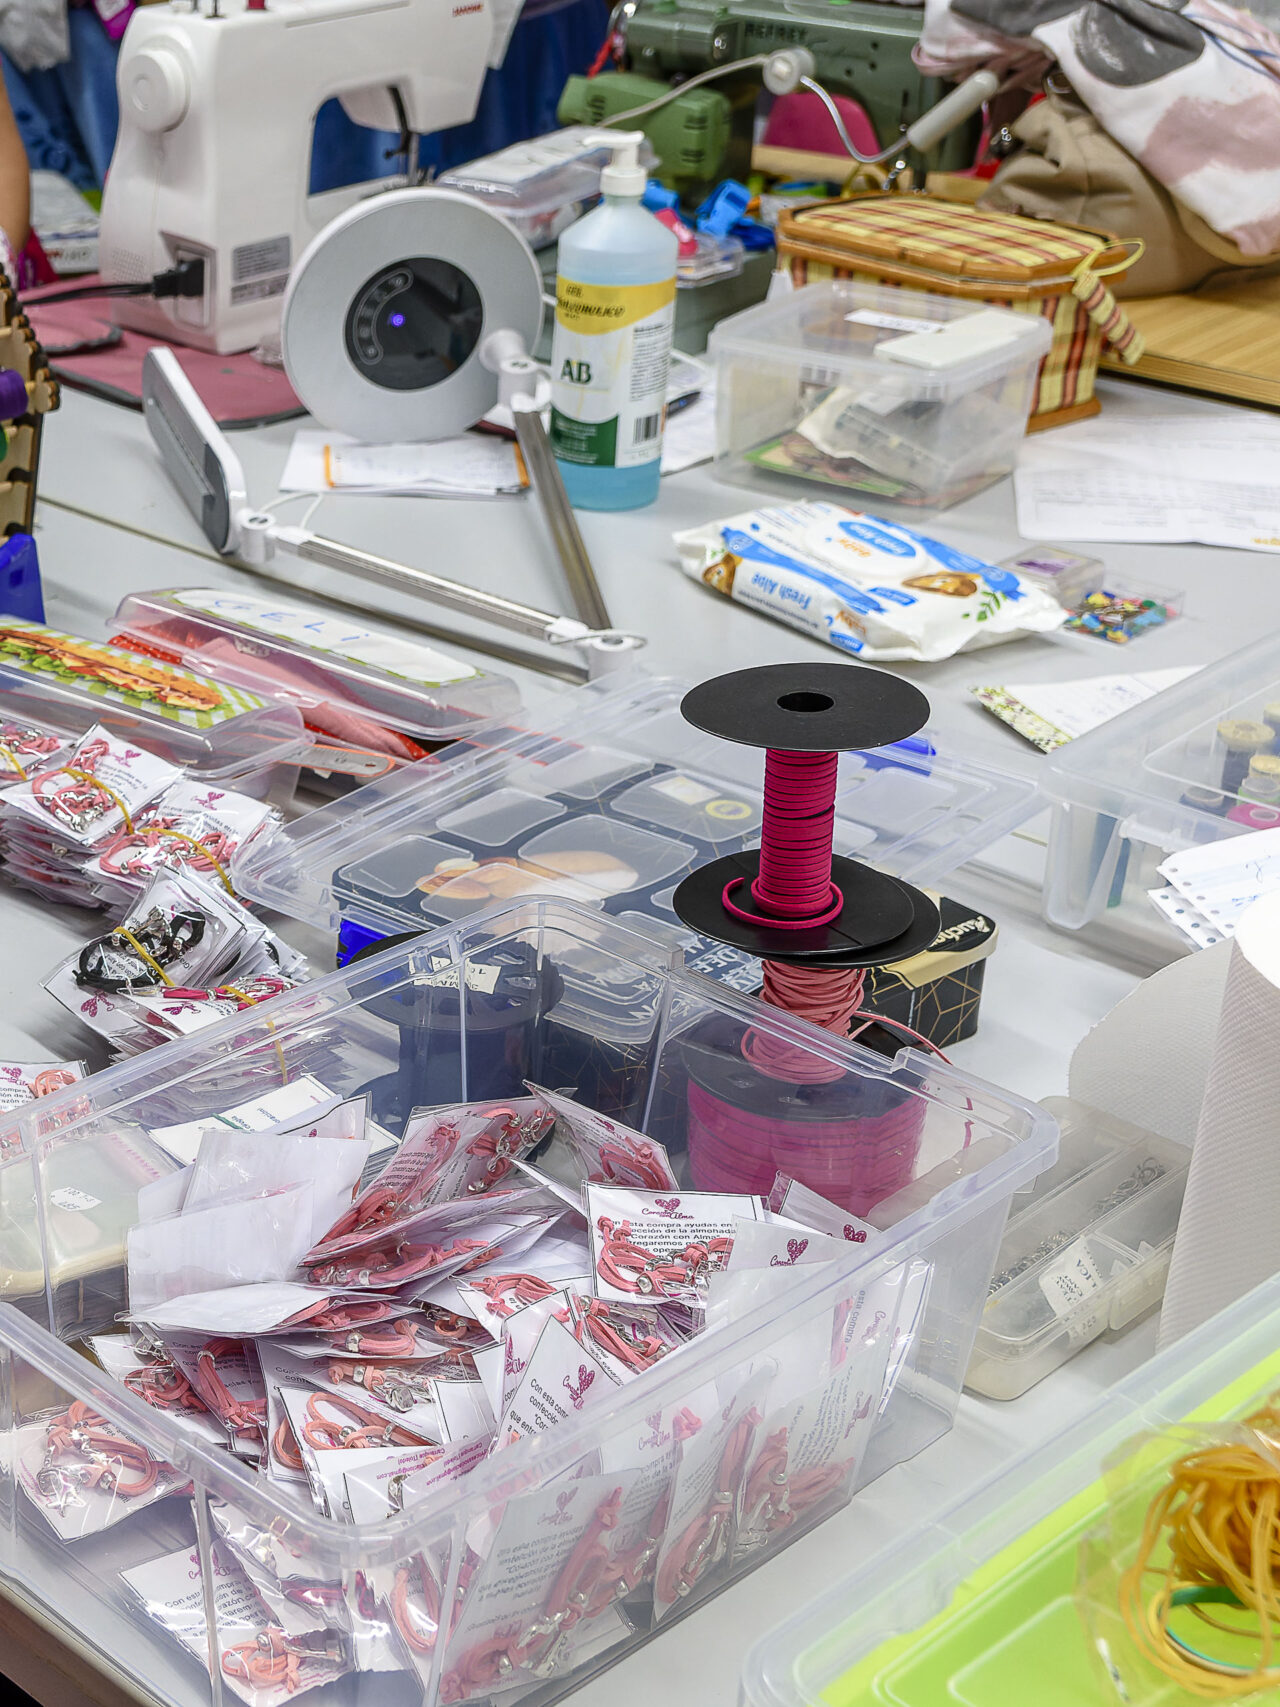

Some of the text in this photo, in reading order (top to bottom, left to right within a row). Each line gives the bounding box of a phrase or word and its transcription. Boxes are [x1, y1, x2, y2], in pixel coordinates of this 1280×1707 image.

[560, 357, 593, 384] AB
[646, 1222, 682, 1230] compra
[684, 1222, 718, 1230] ayudas
[530, 1378, 544, 1394] Con
[542, 1391, 556, 1408] esta
[509, 1409, 522, 1424] que
